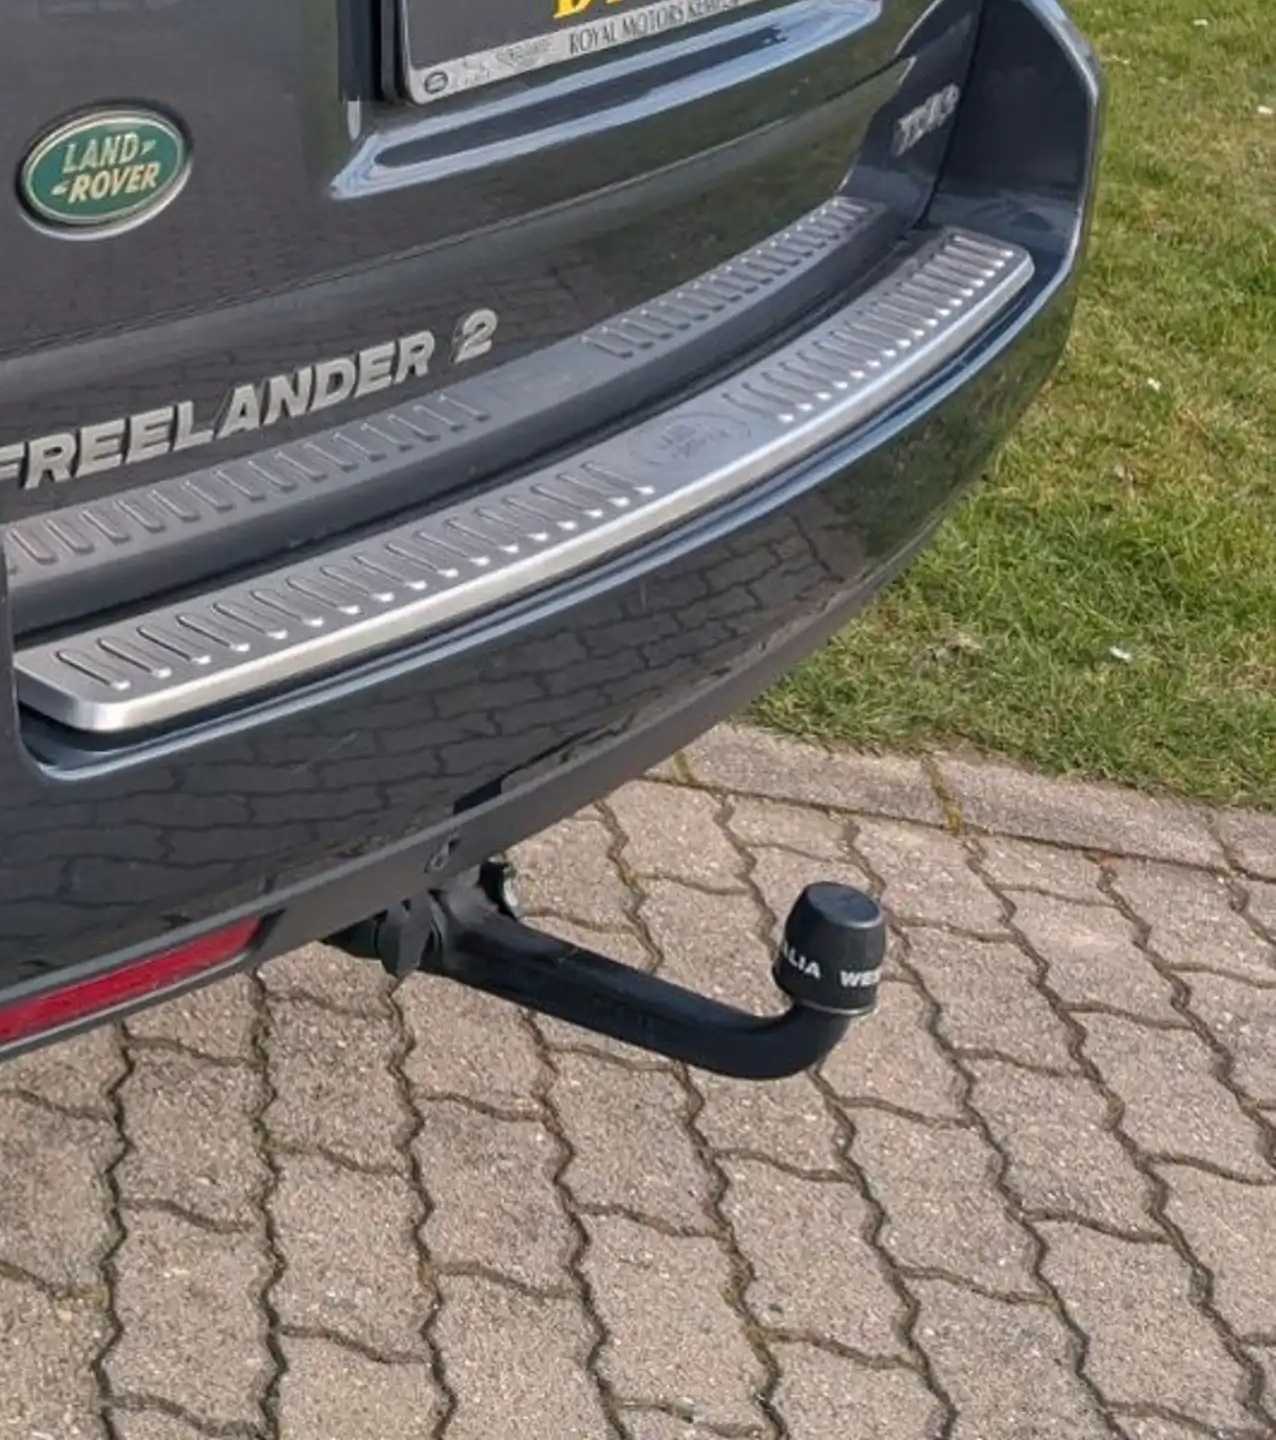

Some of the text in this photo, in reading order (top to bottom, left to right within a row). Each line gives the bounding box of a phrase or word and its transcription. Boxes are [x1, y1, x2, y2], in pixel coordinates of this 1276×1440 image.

[569, 19, 616, 55] ROYAL
[623, 2, 684, 39] MOTORS
[62, 132, 140, 174] LAND
[68, 161, 161, 204] ROVER
[452, 307, 499, 365] 2
